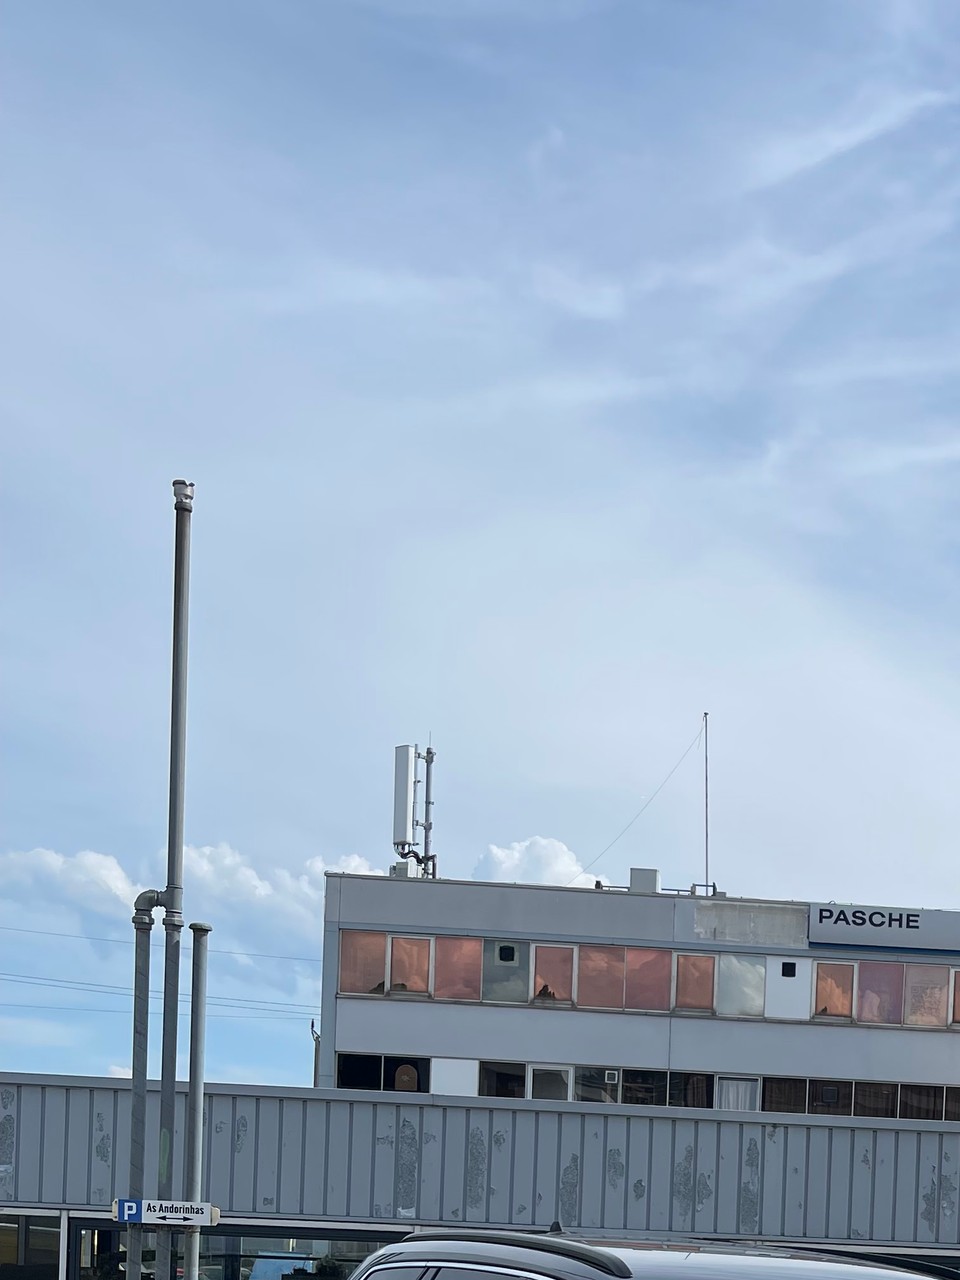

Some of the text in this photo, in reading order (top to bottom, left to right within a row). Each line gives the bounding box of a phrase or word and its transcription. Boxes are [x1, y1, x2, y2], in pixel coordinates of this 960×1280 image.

[818, 908, 920, 929] PASCHE
[124, 1202, 205, 1220] P As Andorinhas
